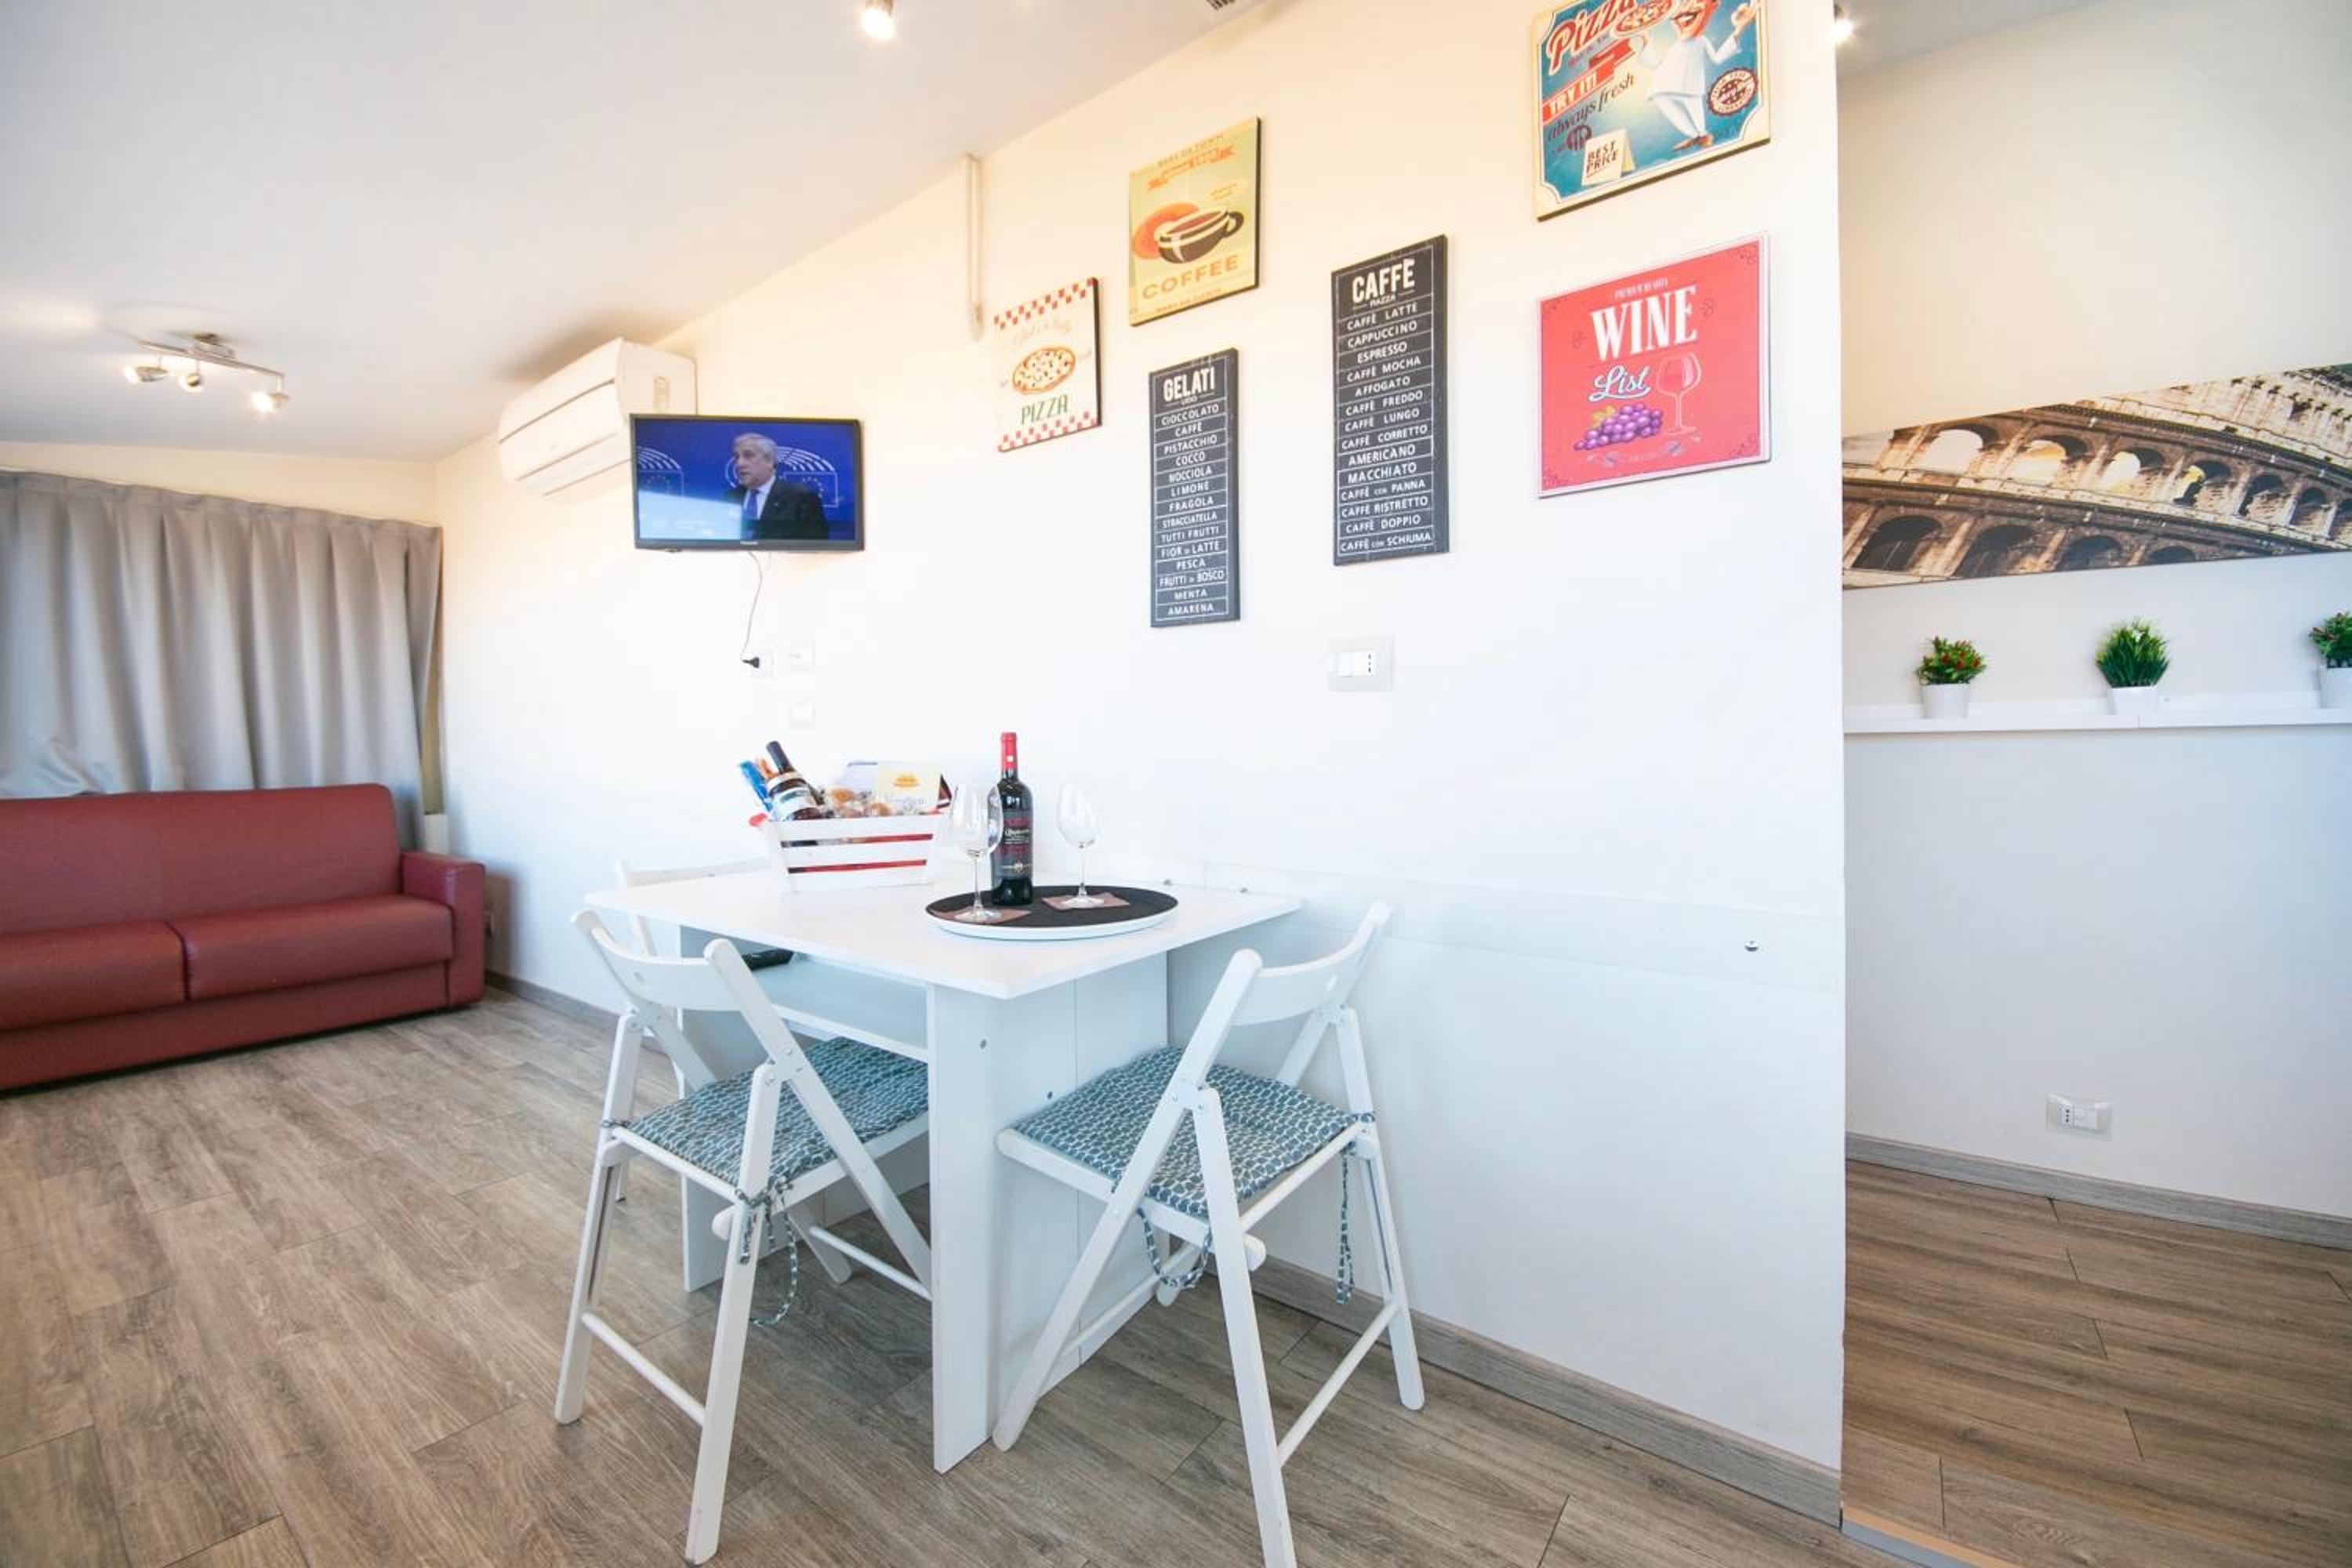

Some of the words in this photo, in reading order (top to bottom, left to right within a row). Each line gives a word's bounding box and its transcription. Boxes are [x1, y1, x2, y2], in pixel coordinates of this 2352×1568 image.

[1598, 71, 1634, 112] fresh
[1588, 141, 1616, 162] BEST
[1586, 149, 1619, 173] PRICE
[1142, 254, 1239, 299] COFFEE
[1385, 302, 1418, 320] LATTE
[1589, 284, 1698, 362] WINE
[1348, 321, 1417, 348] CAPPUCCINO
[1357, 341, 1407, 364] ESPRESSO
[1382, 355, 1421, 374] MOCHA
[1163, 366, 1215, 402] GELATI
[1355, 376, 1410, 397] AFFOGATO
[1588, 364, 1651, 402] List
[1383, 390, 1423, 408] FREDDO
[1021, 394, 1069, 426] PIZZA
[1161, 404, 1220, 426] CIOCCOLATO
[1384, 408, 1420, 424] LUNGO
[1377, 424, 1428, 443] CORRETTO
[1163, 434, 1218, 456] PISTACCHIO
[1176, 451, 1206, 466] COCCO
[1348, 444, 1416, 466] AMERICANO
[1169, 466, 1213, 484] NOCCIOLA
[1348, 462, 1417, 484] MACCHIATO
[1171, 481, 1210, 498] LIMONE
[1392, 479, 1426, 493] PANNA
[1170, 495, 1214, 512] FRAGOLA
[1374, 496, 1428, 514] RISTRETTO
[1162, 511, 1218, 529] STRACCIATELLA
[1381, 514, 1421, 529] DOPPIO
[1161, 532, 1185, 543] TUTTI
[1188, 526, 1219, 541] FRUTTI
[1387, 532, 1431, 546] SCHIUMA
[1161, 547, 1182, 559] FIOR
[1192, 541, 1220, 554] LATTE
[1177, 558, 1206, 571] PESCA
[1160, 575, 1187, 588] FRUTTI
[1197, 570, 1225, 583] BOSCO
[1174, 589, 1208, 600] MENTA
[1167, 603, 1214, 615] AMARENA
